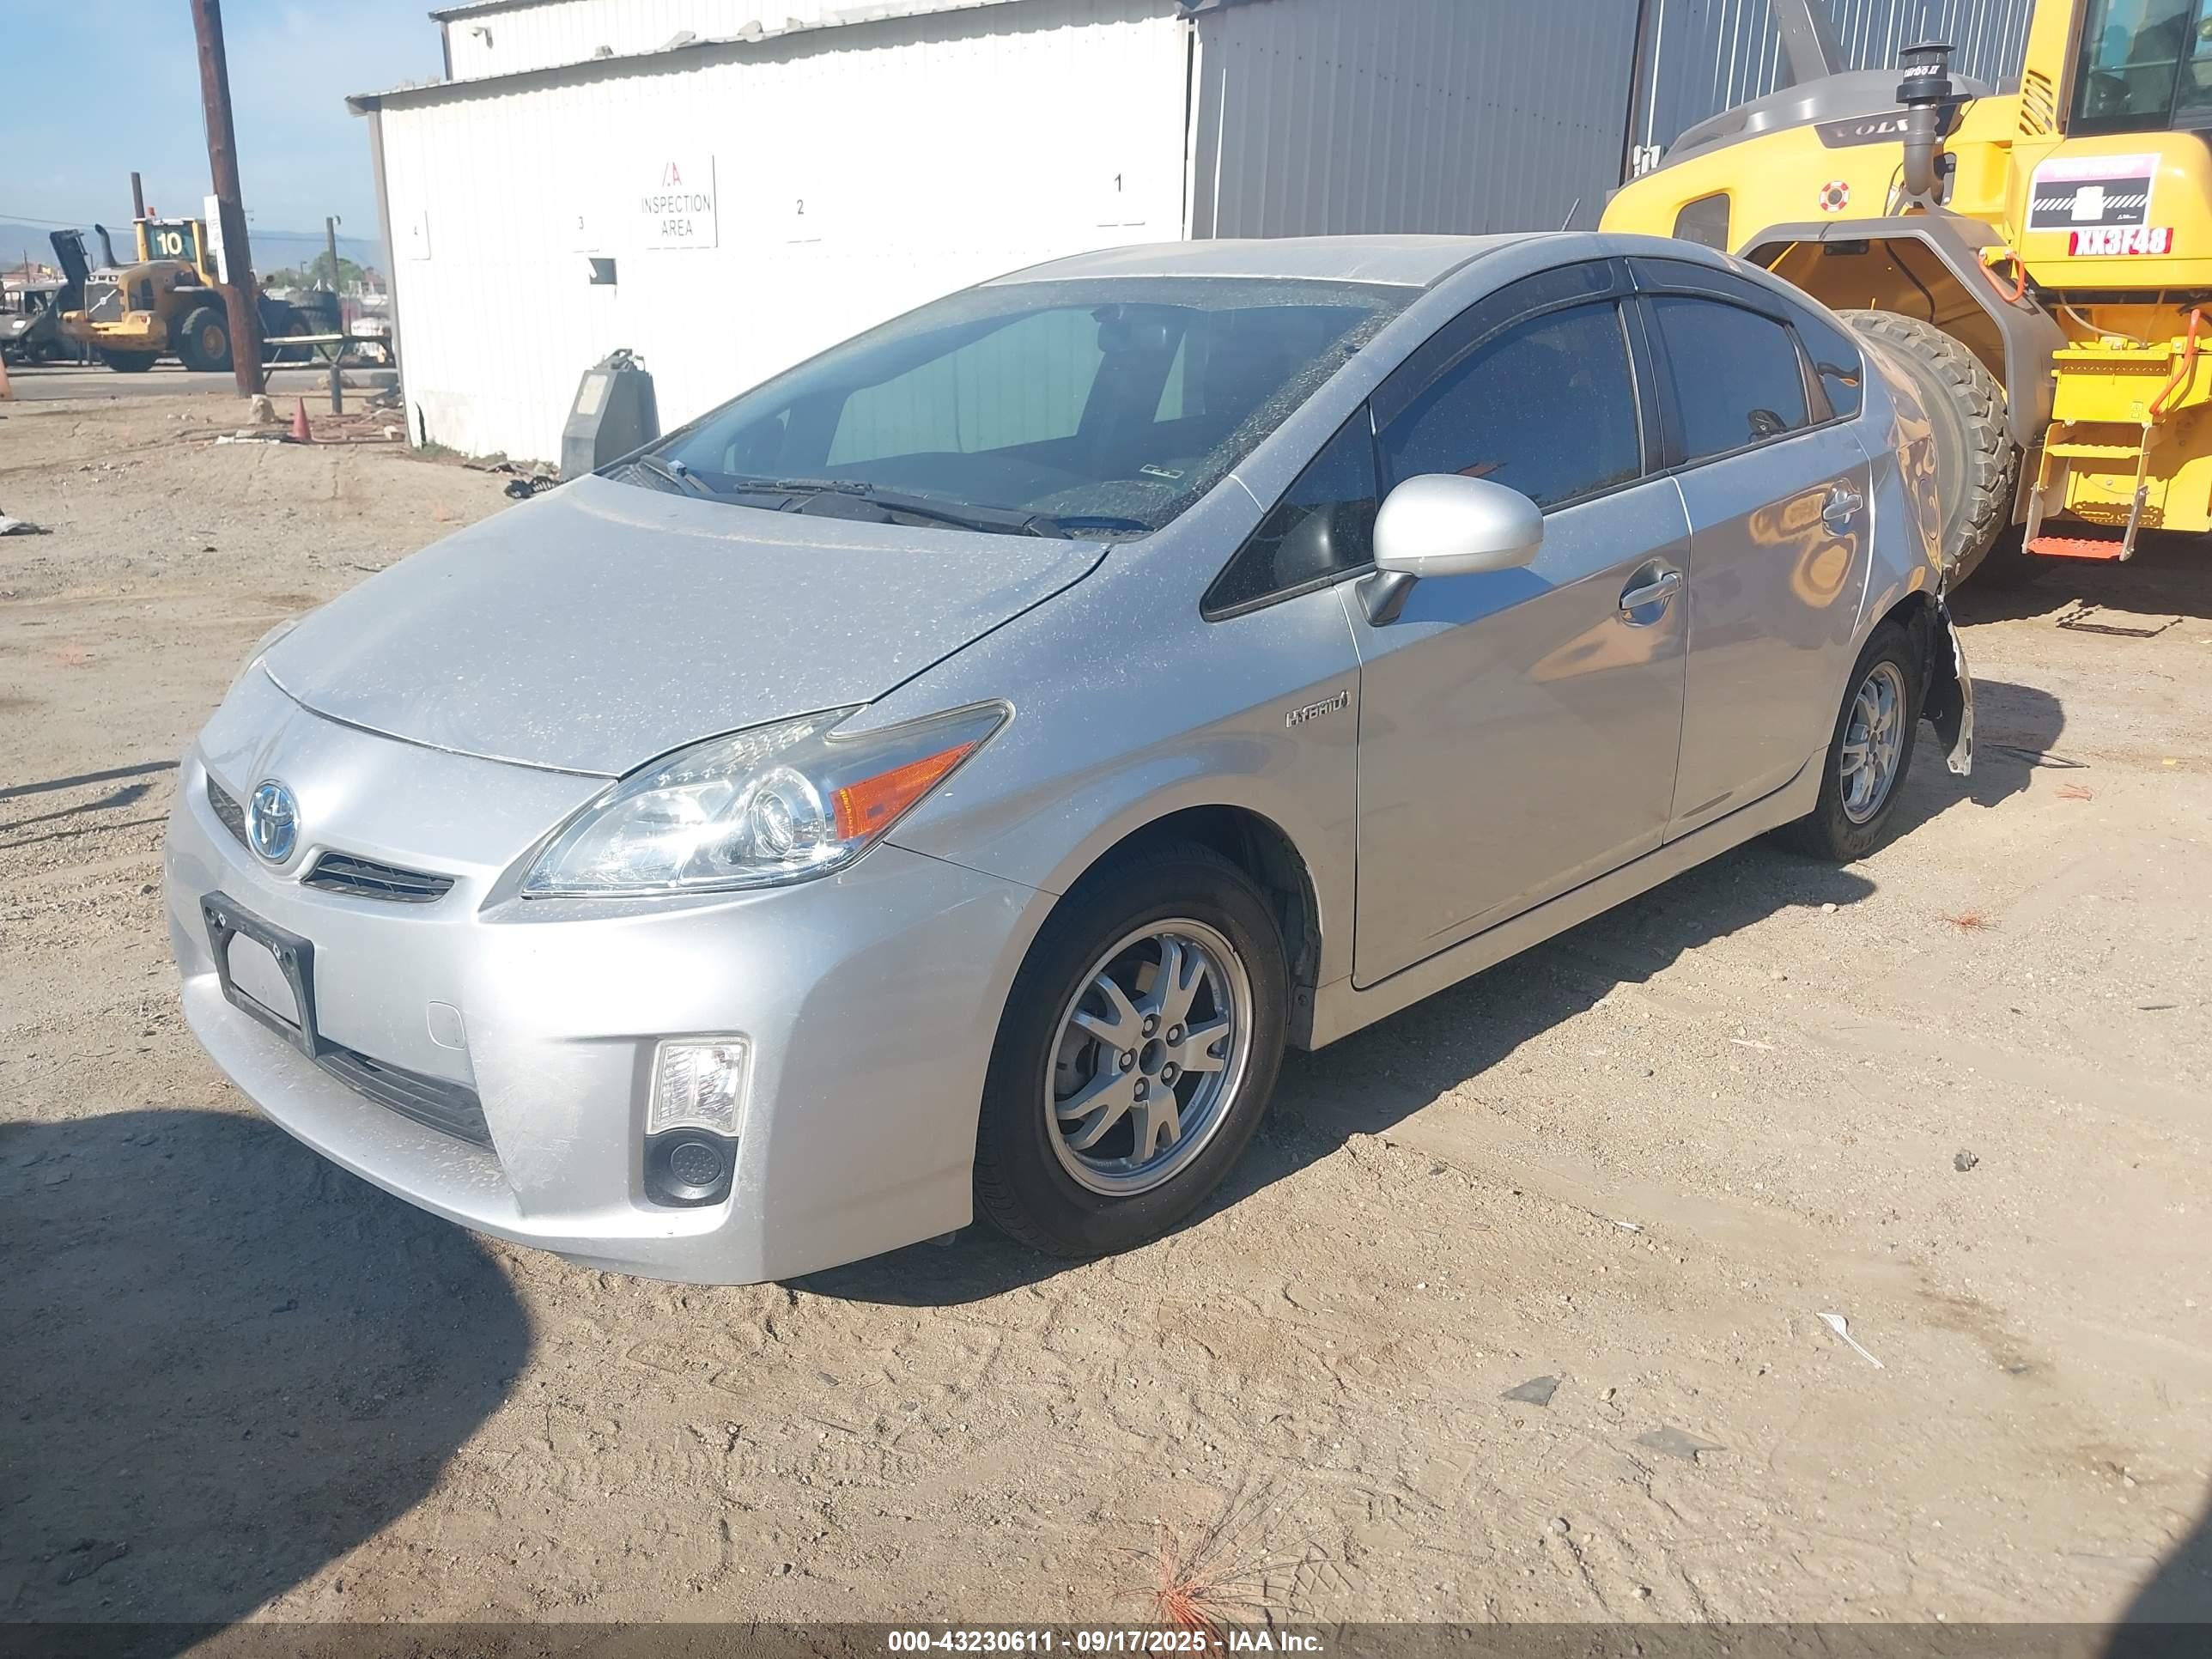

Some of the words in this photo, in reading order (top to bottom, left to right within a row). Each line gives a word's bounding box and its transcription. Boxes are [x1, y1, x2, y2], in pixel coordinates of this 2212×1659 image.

[1115, 173, 1121, 193] 1
[641, 194, 711, 214] INSPECTION
[797, 198, 804, 215] 2
[662, 219, 694, 236] AREA
[157, 232, 183, 255] 10
[2074, 228, 2168, 256] XX3F48
[1285, 690, 1350, 729] HYBRID
